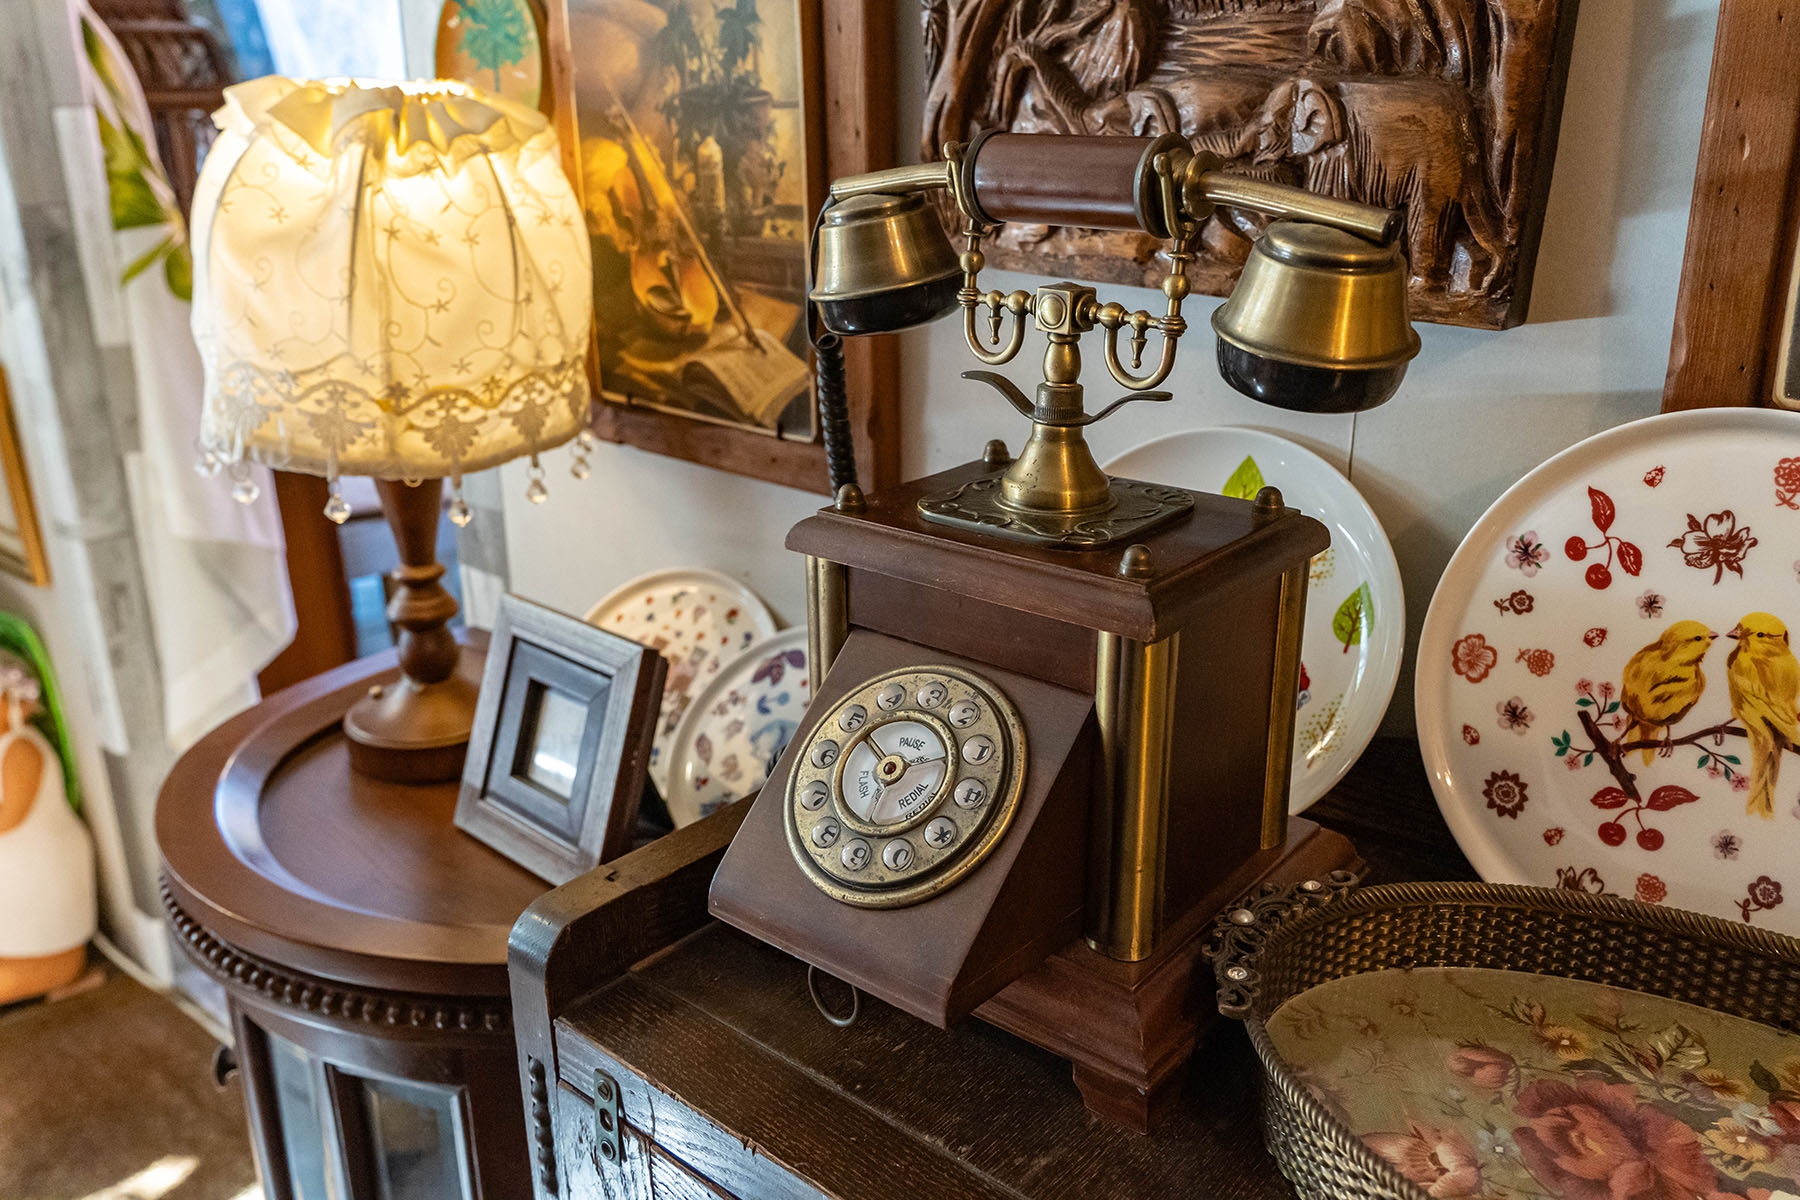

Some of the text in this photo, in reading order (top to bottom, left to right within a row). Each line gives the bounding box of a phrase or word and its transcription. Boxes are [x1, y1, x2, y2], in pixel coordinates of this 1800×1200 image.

[925, 689, 942, 707] 3
[847, 712, 863, 728] 5
[957, 706, 975, 726] 2
[898, 736, 926, 751] PAUSE
[820, 749, 835, 766] 6
[971, 744, 988, 762] 1
[859, 770, 870, 799] FLASH
[898, 782, 929, 810] REDIAL
[850, 847, 866, 865] 9
